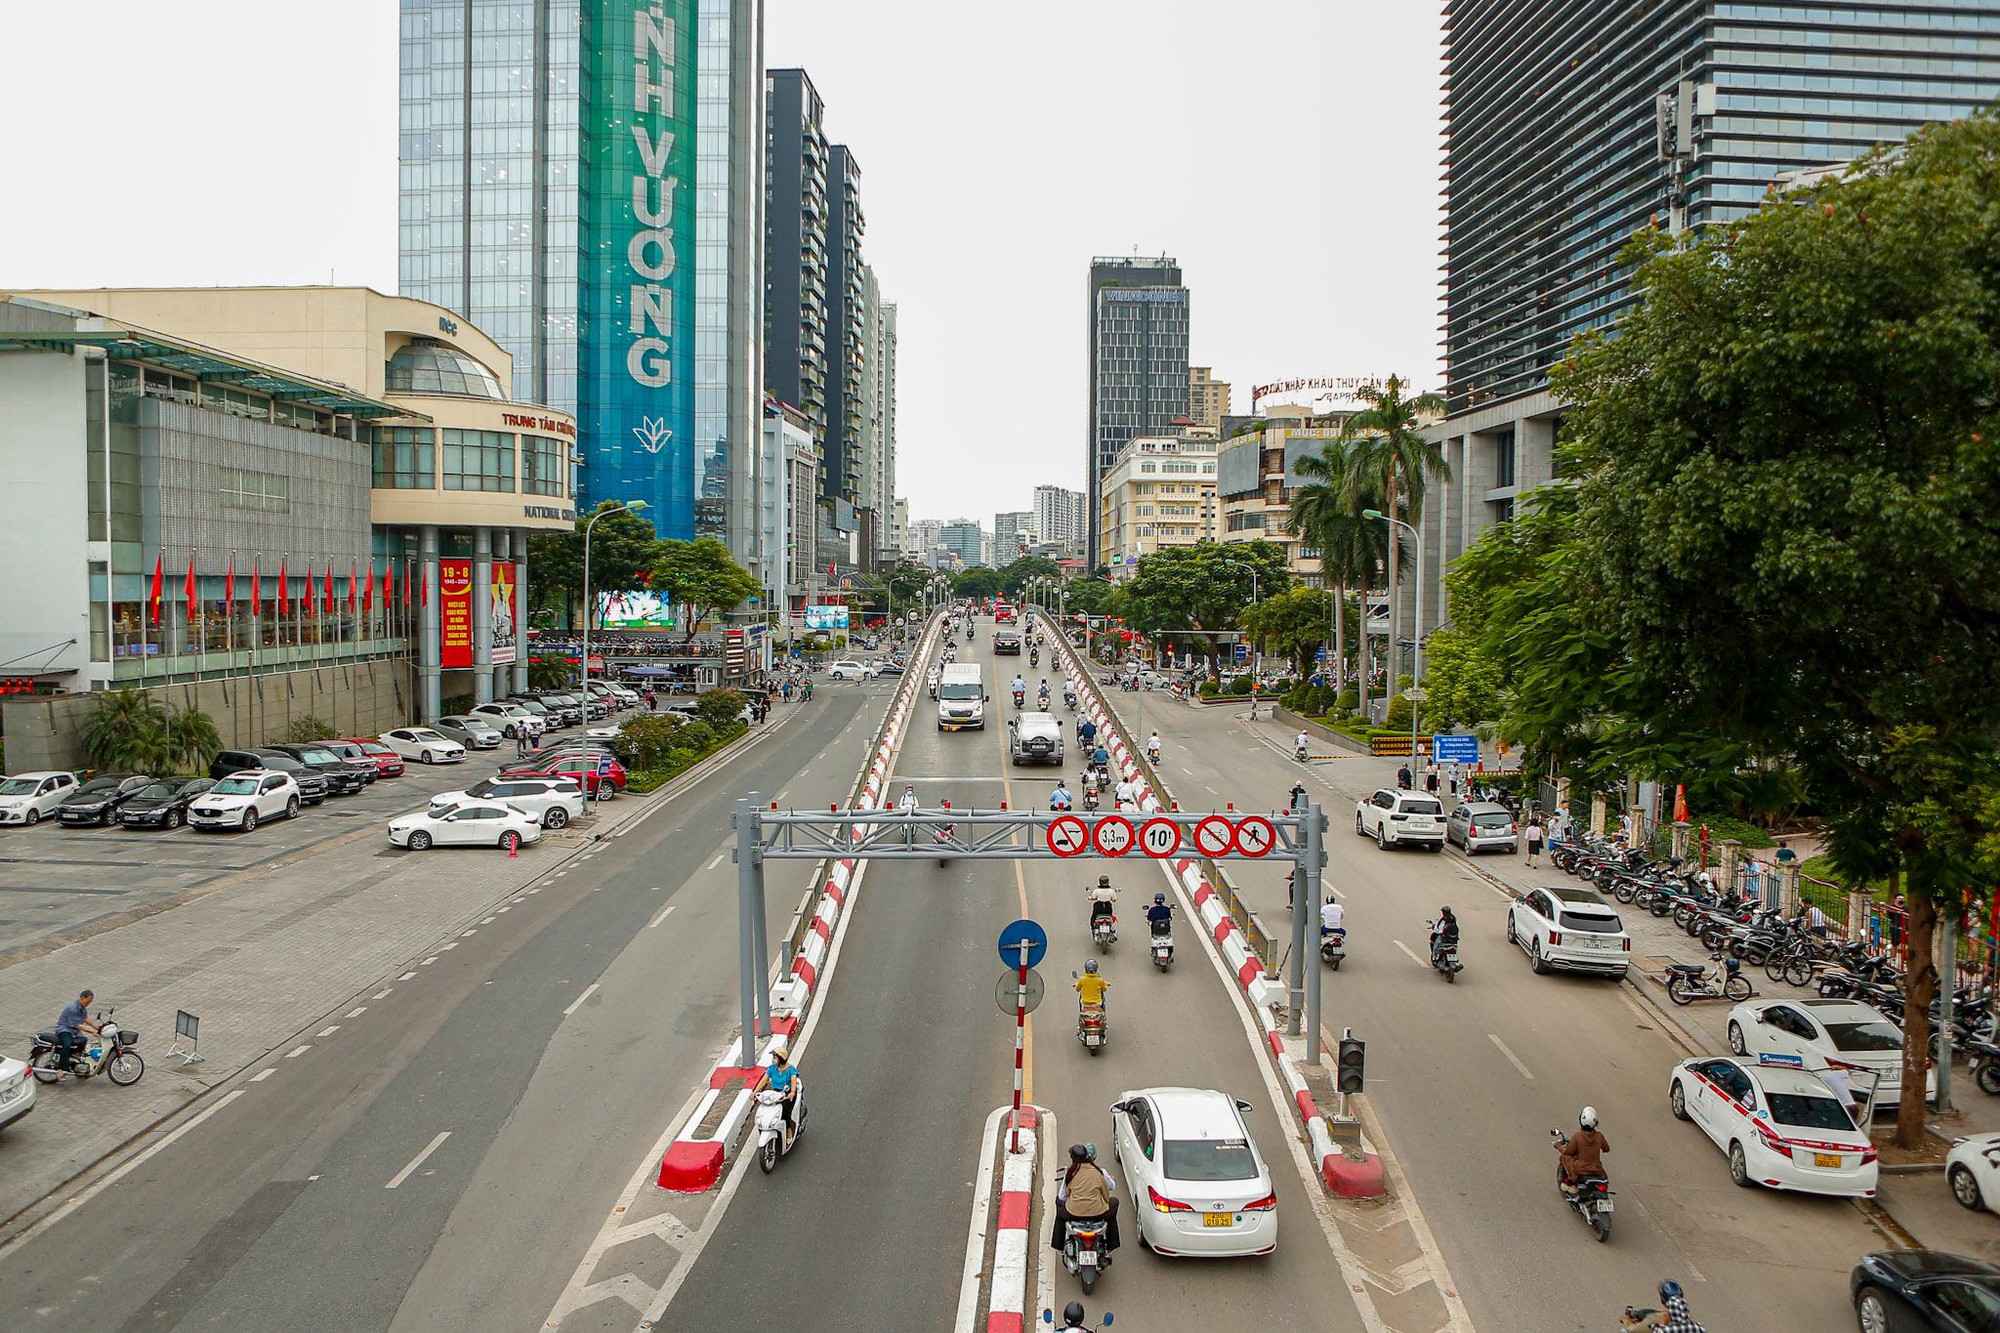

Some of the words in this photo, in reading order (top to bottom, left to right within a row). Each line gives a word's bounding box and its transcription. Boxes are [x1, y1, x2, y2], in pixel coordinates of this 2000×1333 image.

[1105, 290, 1185, 303] VINACONEX
[502, 413, 536, 429] TRUNG
[539, 415, 555, 432] TÂM
[524, 505, 561, 520] NATIONAL
[443, 567, 455, 578] 19
[462, 567, 469, 578] 8
